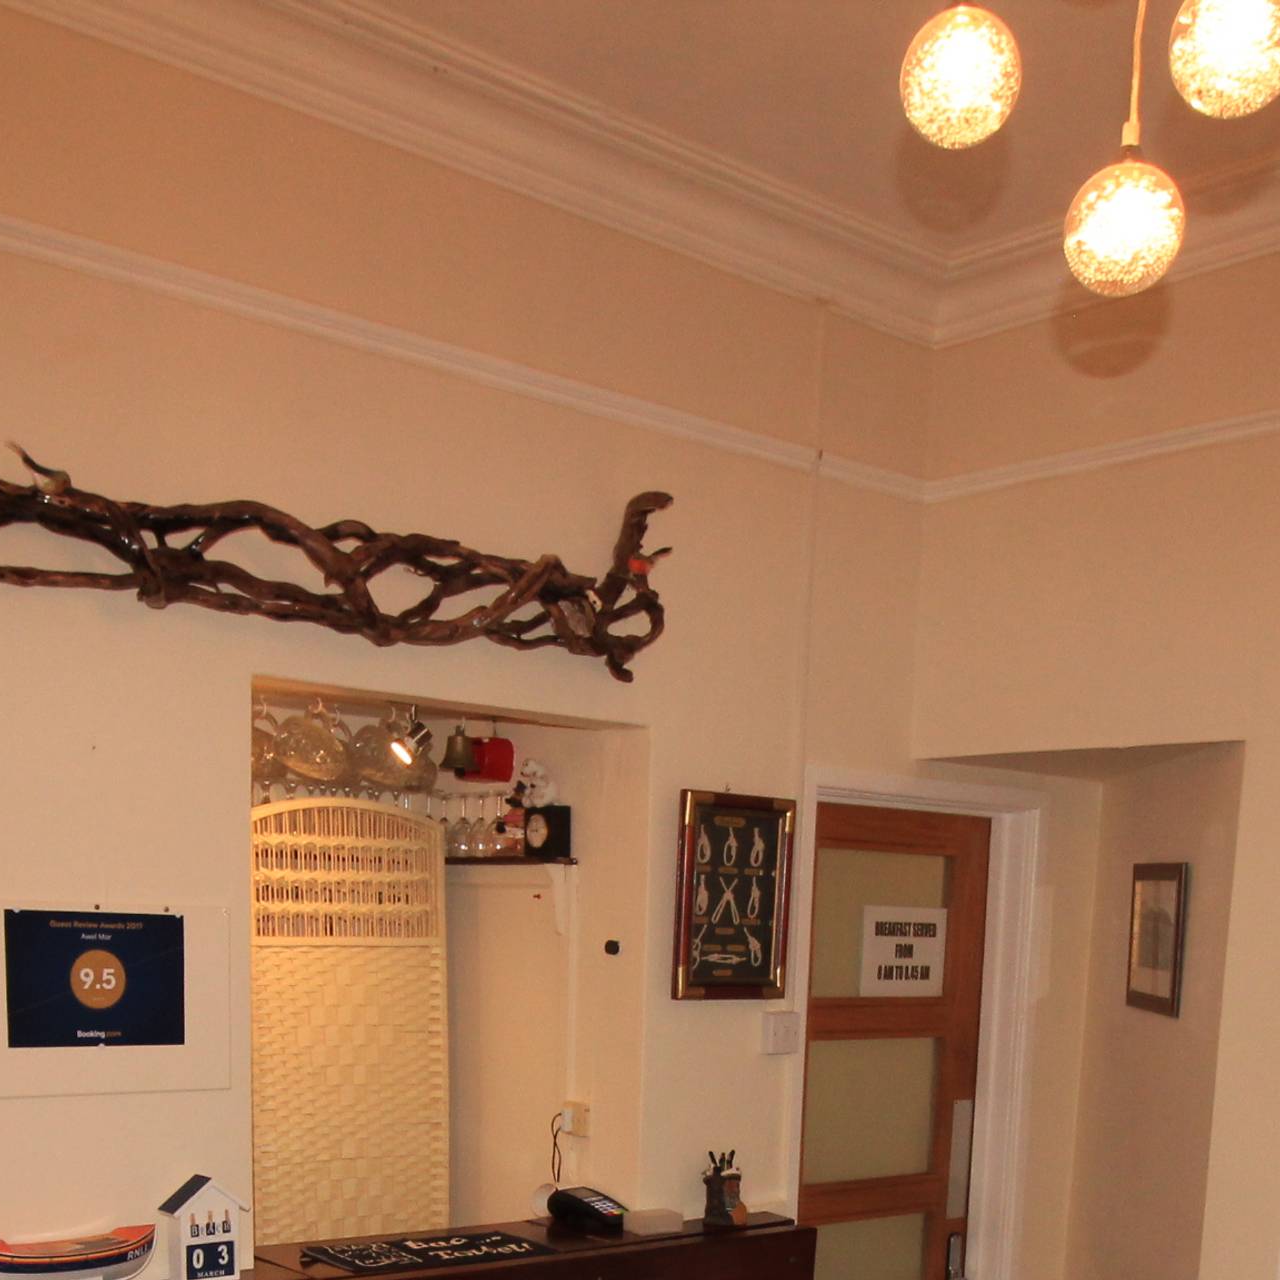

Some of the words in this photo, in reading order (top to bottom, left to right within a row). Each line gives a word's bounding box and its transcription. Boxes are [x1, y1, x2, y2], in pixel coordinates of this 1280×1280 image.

[48, 919, 72, 929] Guest
[73, 920, 98, 929] Review
[100, 921, 125, 930] Awards
[875, 921, 912, 937] BREAKFAST
[913, 922, 937, 938] SERVED
[895, 943, 914, 959] FROM
[80, 967, 117, 990] 9.5
[883, 965, 894, 980] AM
[895, 965, 904, 980] TO
[920, 965, 931, 981] AM
[127, 1243, 149, 1261] RNLI
[196, 1269, 225, 1278] MARCH
